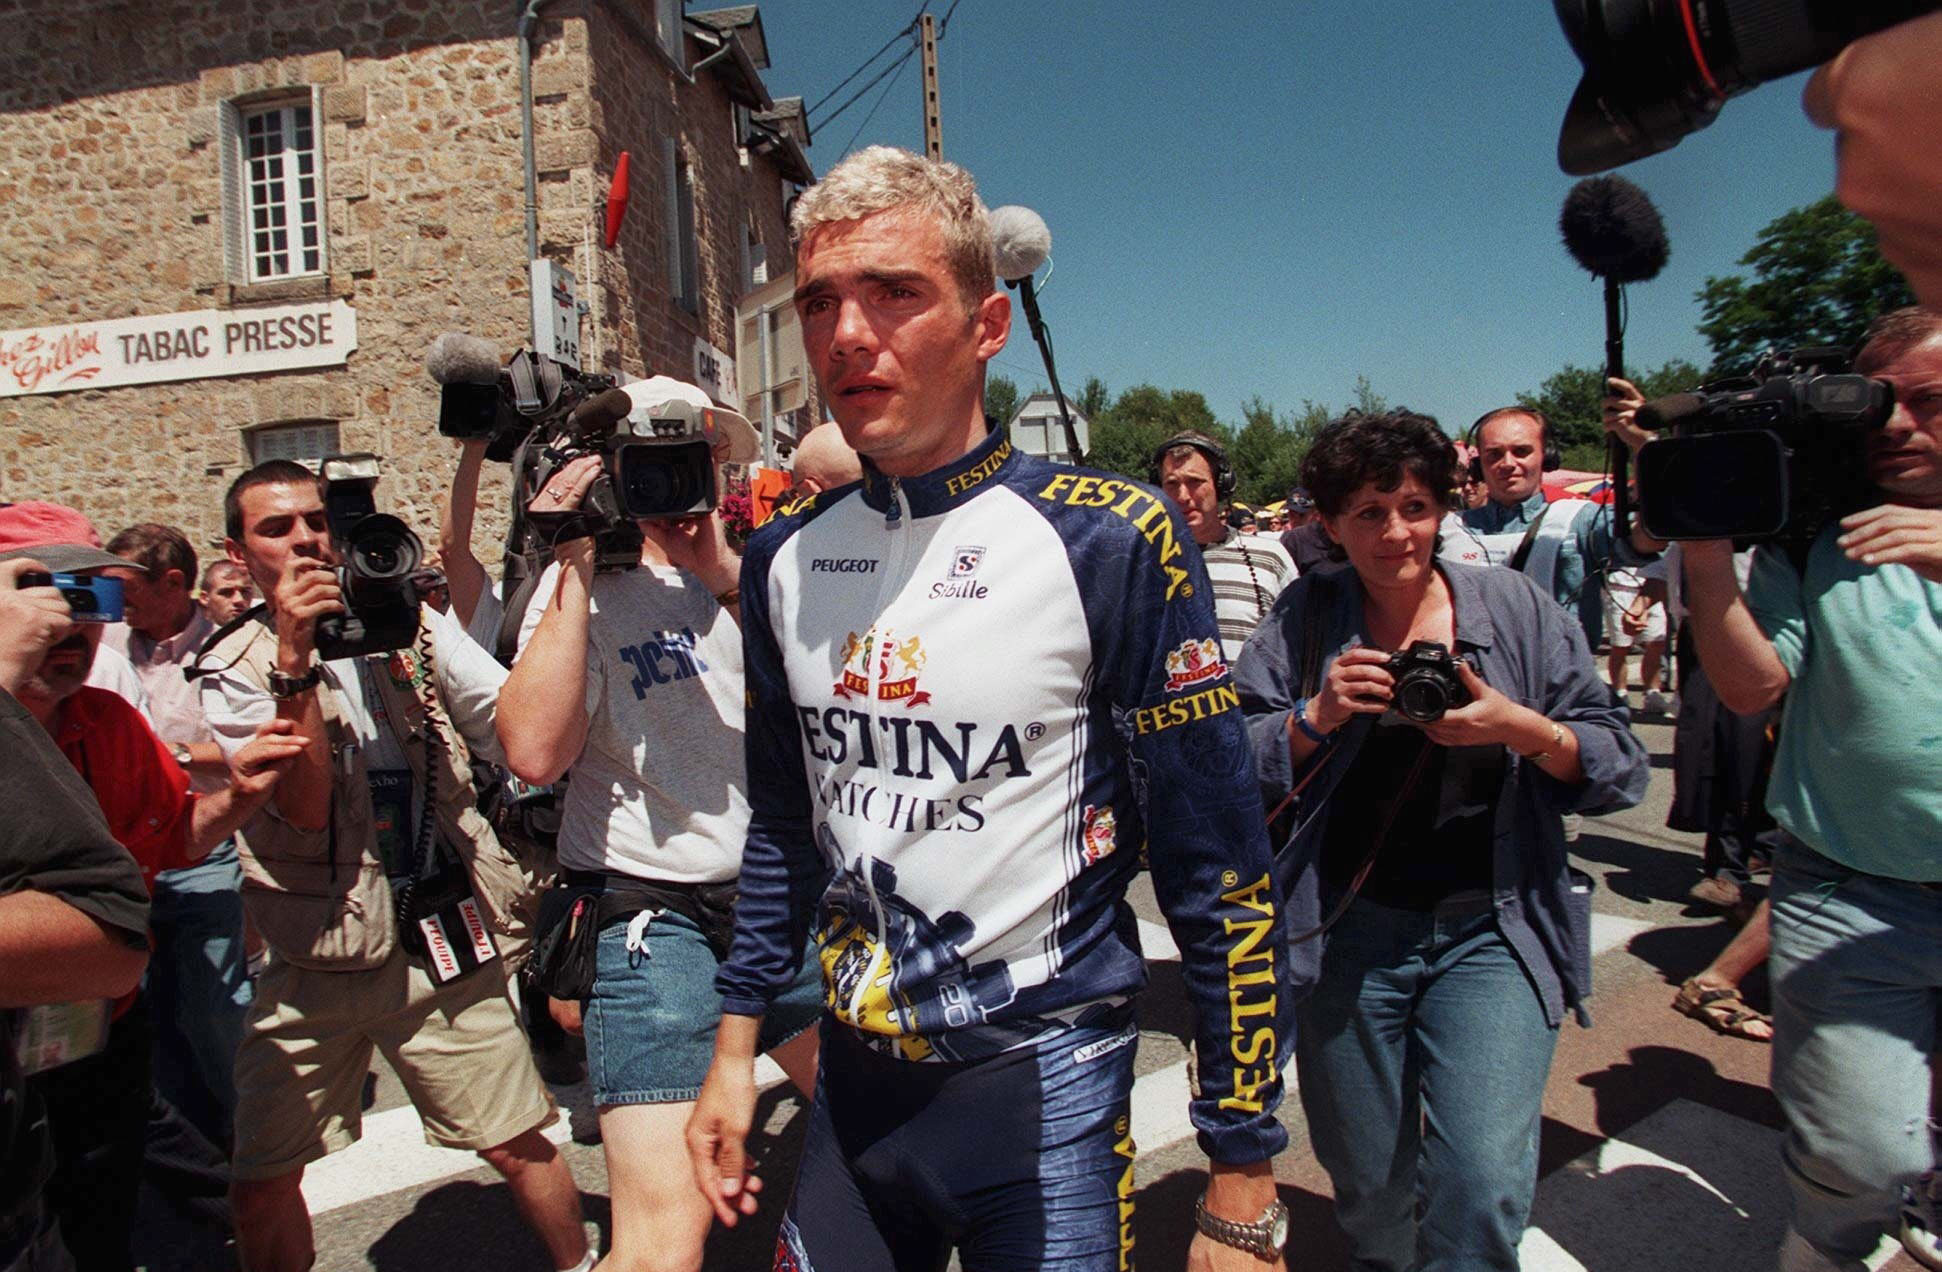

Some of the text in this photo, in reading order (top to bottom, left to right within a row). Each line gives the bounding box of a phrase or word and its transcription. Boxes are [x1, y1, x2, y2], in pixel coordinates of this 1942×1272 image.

[118, 312, 334, 365] TABAC PRESSE
[811, 559, 880, 573] PEUGEOT
[928, 580, 989, 599] Sibille
[847, 675, 912, 698] FESINA
